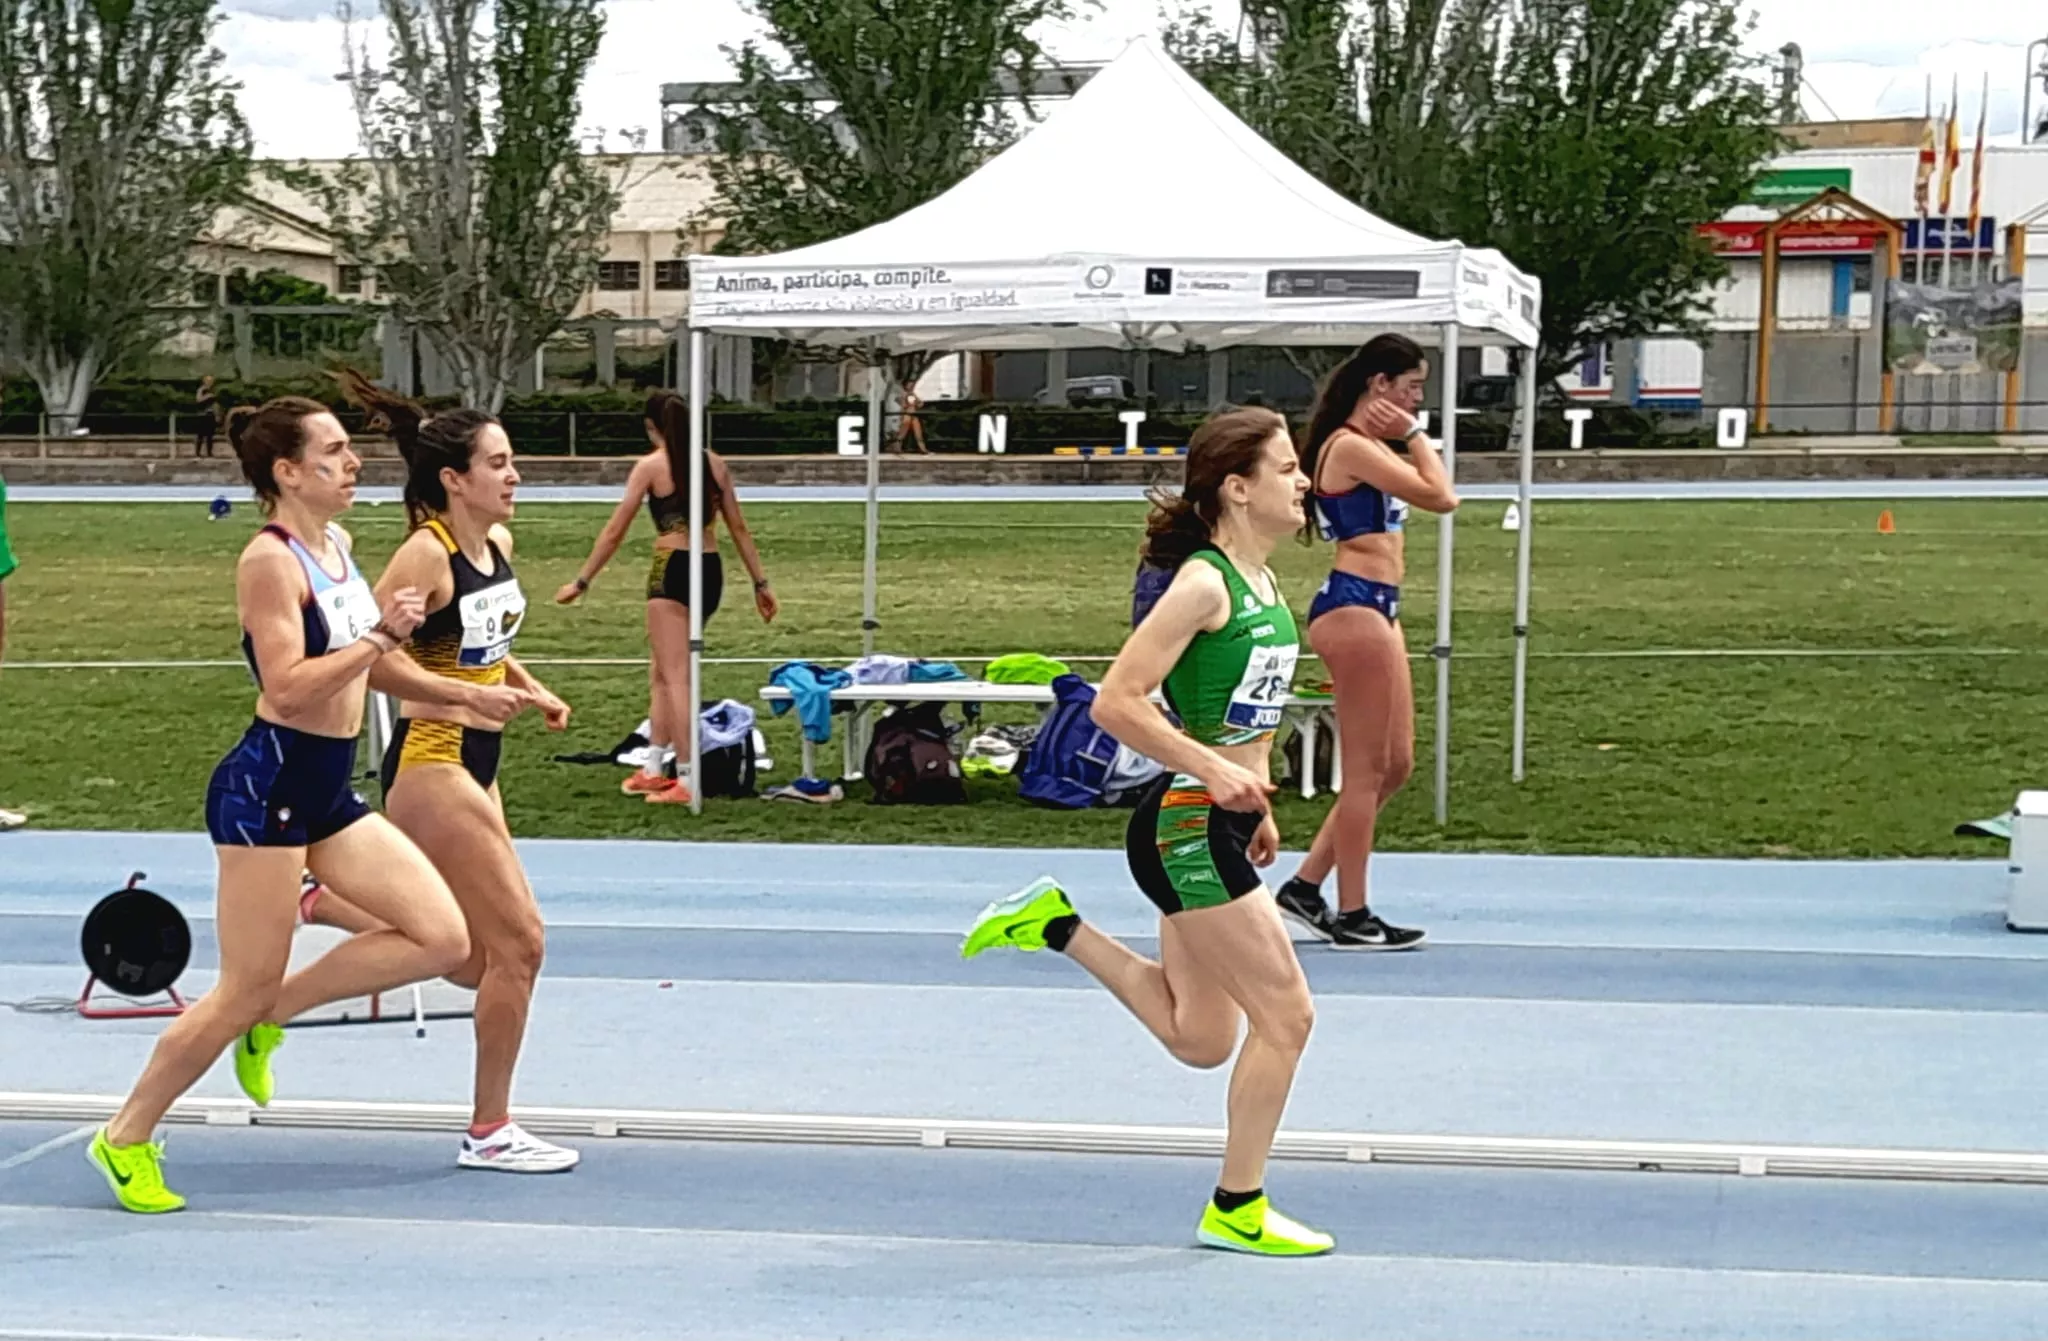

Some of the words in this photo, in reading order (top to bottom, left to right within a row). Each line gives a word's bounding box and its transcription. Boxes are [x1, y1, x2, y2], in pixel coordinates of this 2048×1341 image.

[715, 272, 778, 293] Anima,
[783, 269, 868, 294] participa,
[873, 267, 952, 289] compite.
